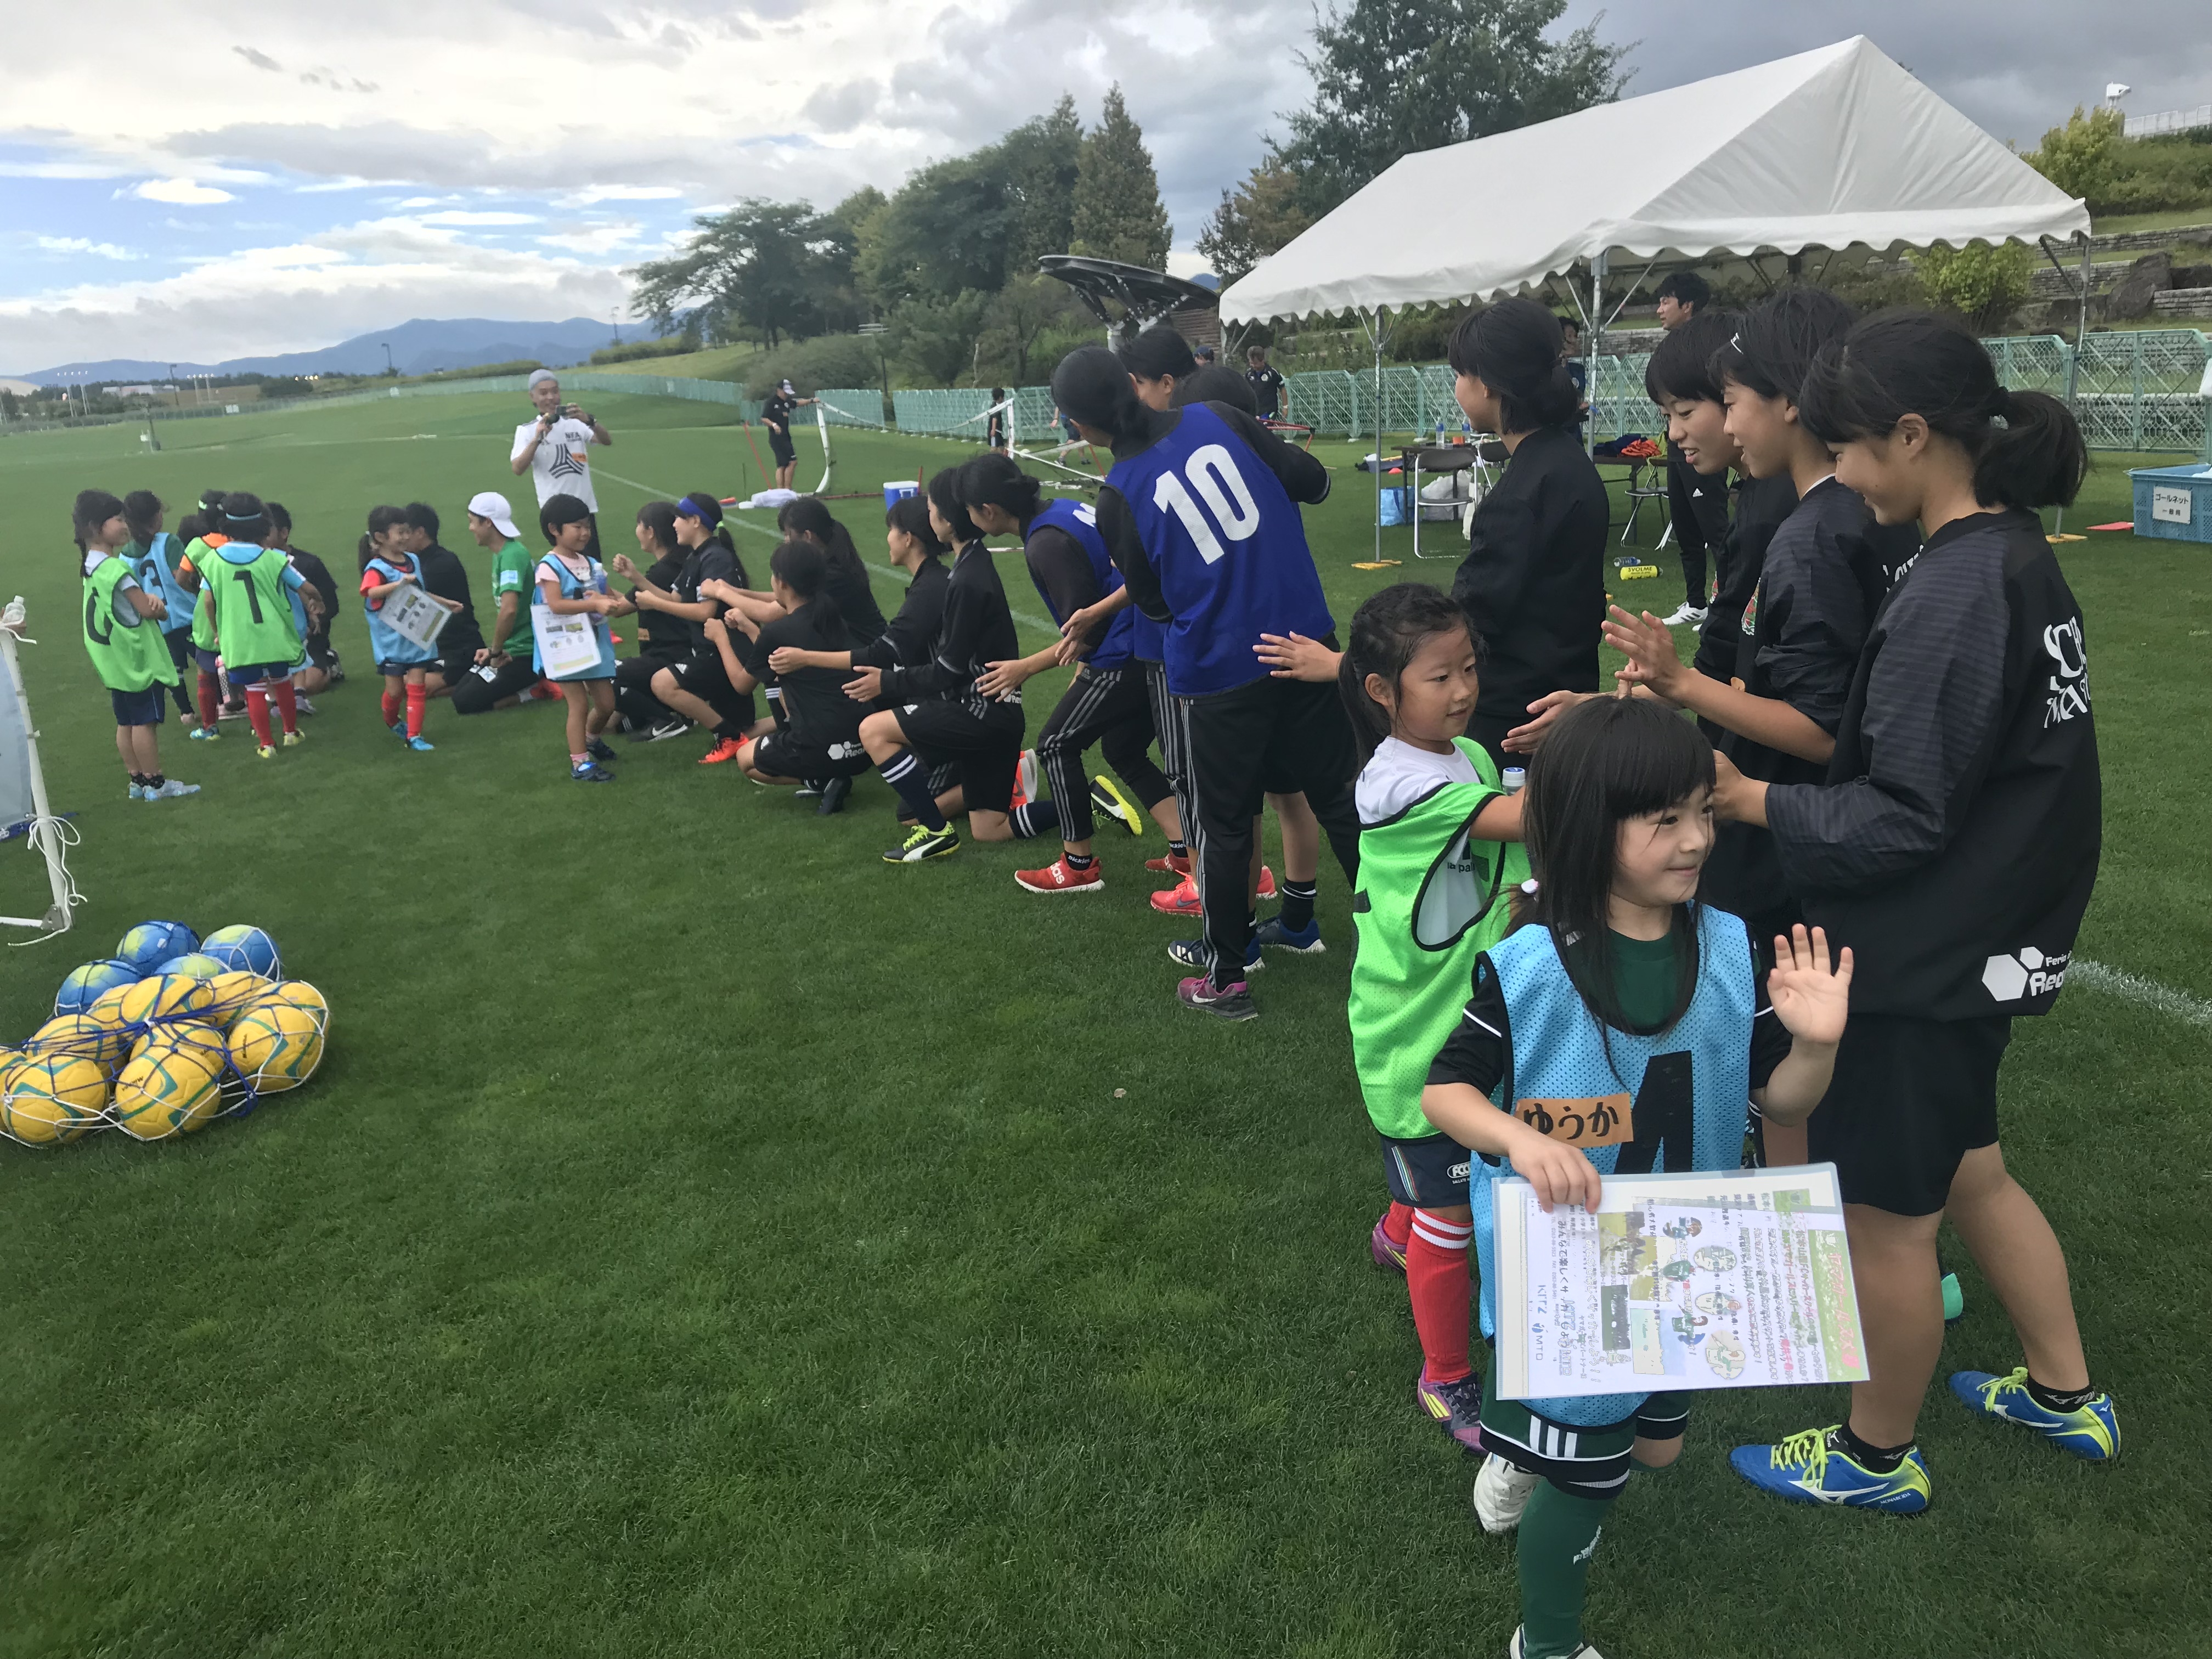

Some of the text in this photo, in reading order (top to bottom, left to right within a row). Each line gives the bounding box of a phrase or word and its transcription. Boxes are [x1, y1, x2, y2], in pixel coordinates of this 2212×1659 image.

[1153, 444, 1260, 565] 10
[2155, 494, 2188, 504] ゴールネット
[233, 569, 263, 624] 1
[1523, 1102, 1620, 1140] ゆうか
[1880, 1492, 1911, 1504] MONARCIDA
